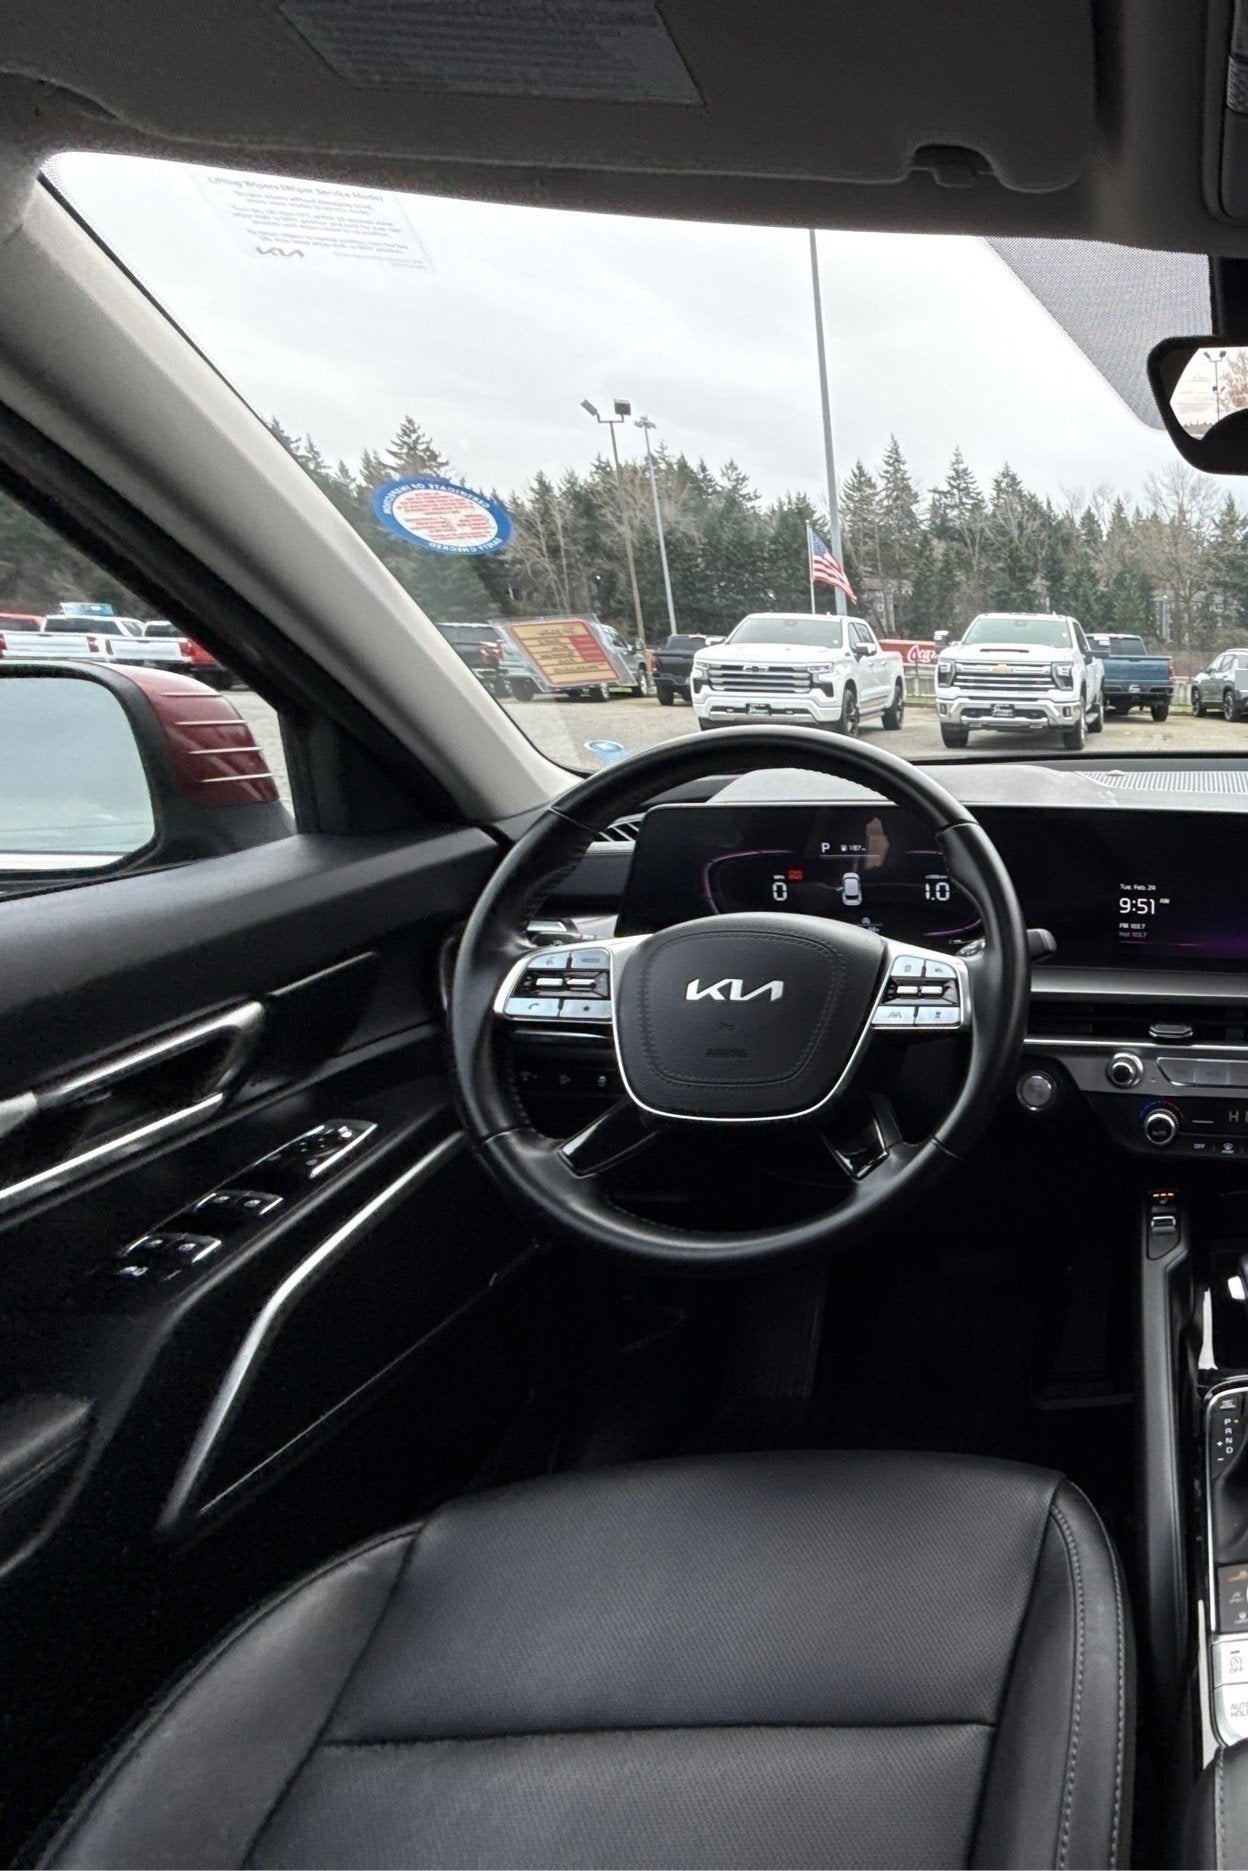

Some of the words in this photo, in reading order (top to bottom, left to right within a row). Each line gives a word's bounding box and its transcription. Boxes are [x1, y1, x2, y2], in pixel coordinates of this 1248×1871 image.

[821, 842, 830, 853] P
[772, 881, 788, 902] 0
[925, 881, 951, 902] 1.0
[1118, 897, 1156, 915] 9:51
[685, 978, 784, 1002] KIA
[1224, 1418, 1232, 1426] P
[1226, 1446, 1234, 1454] D
